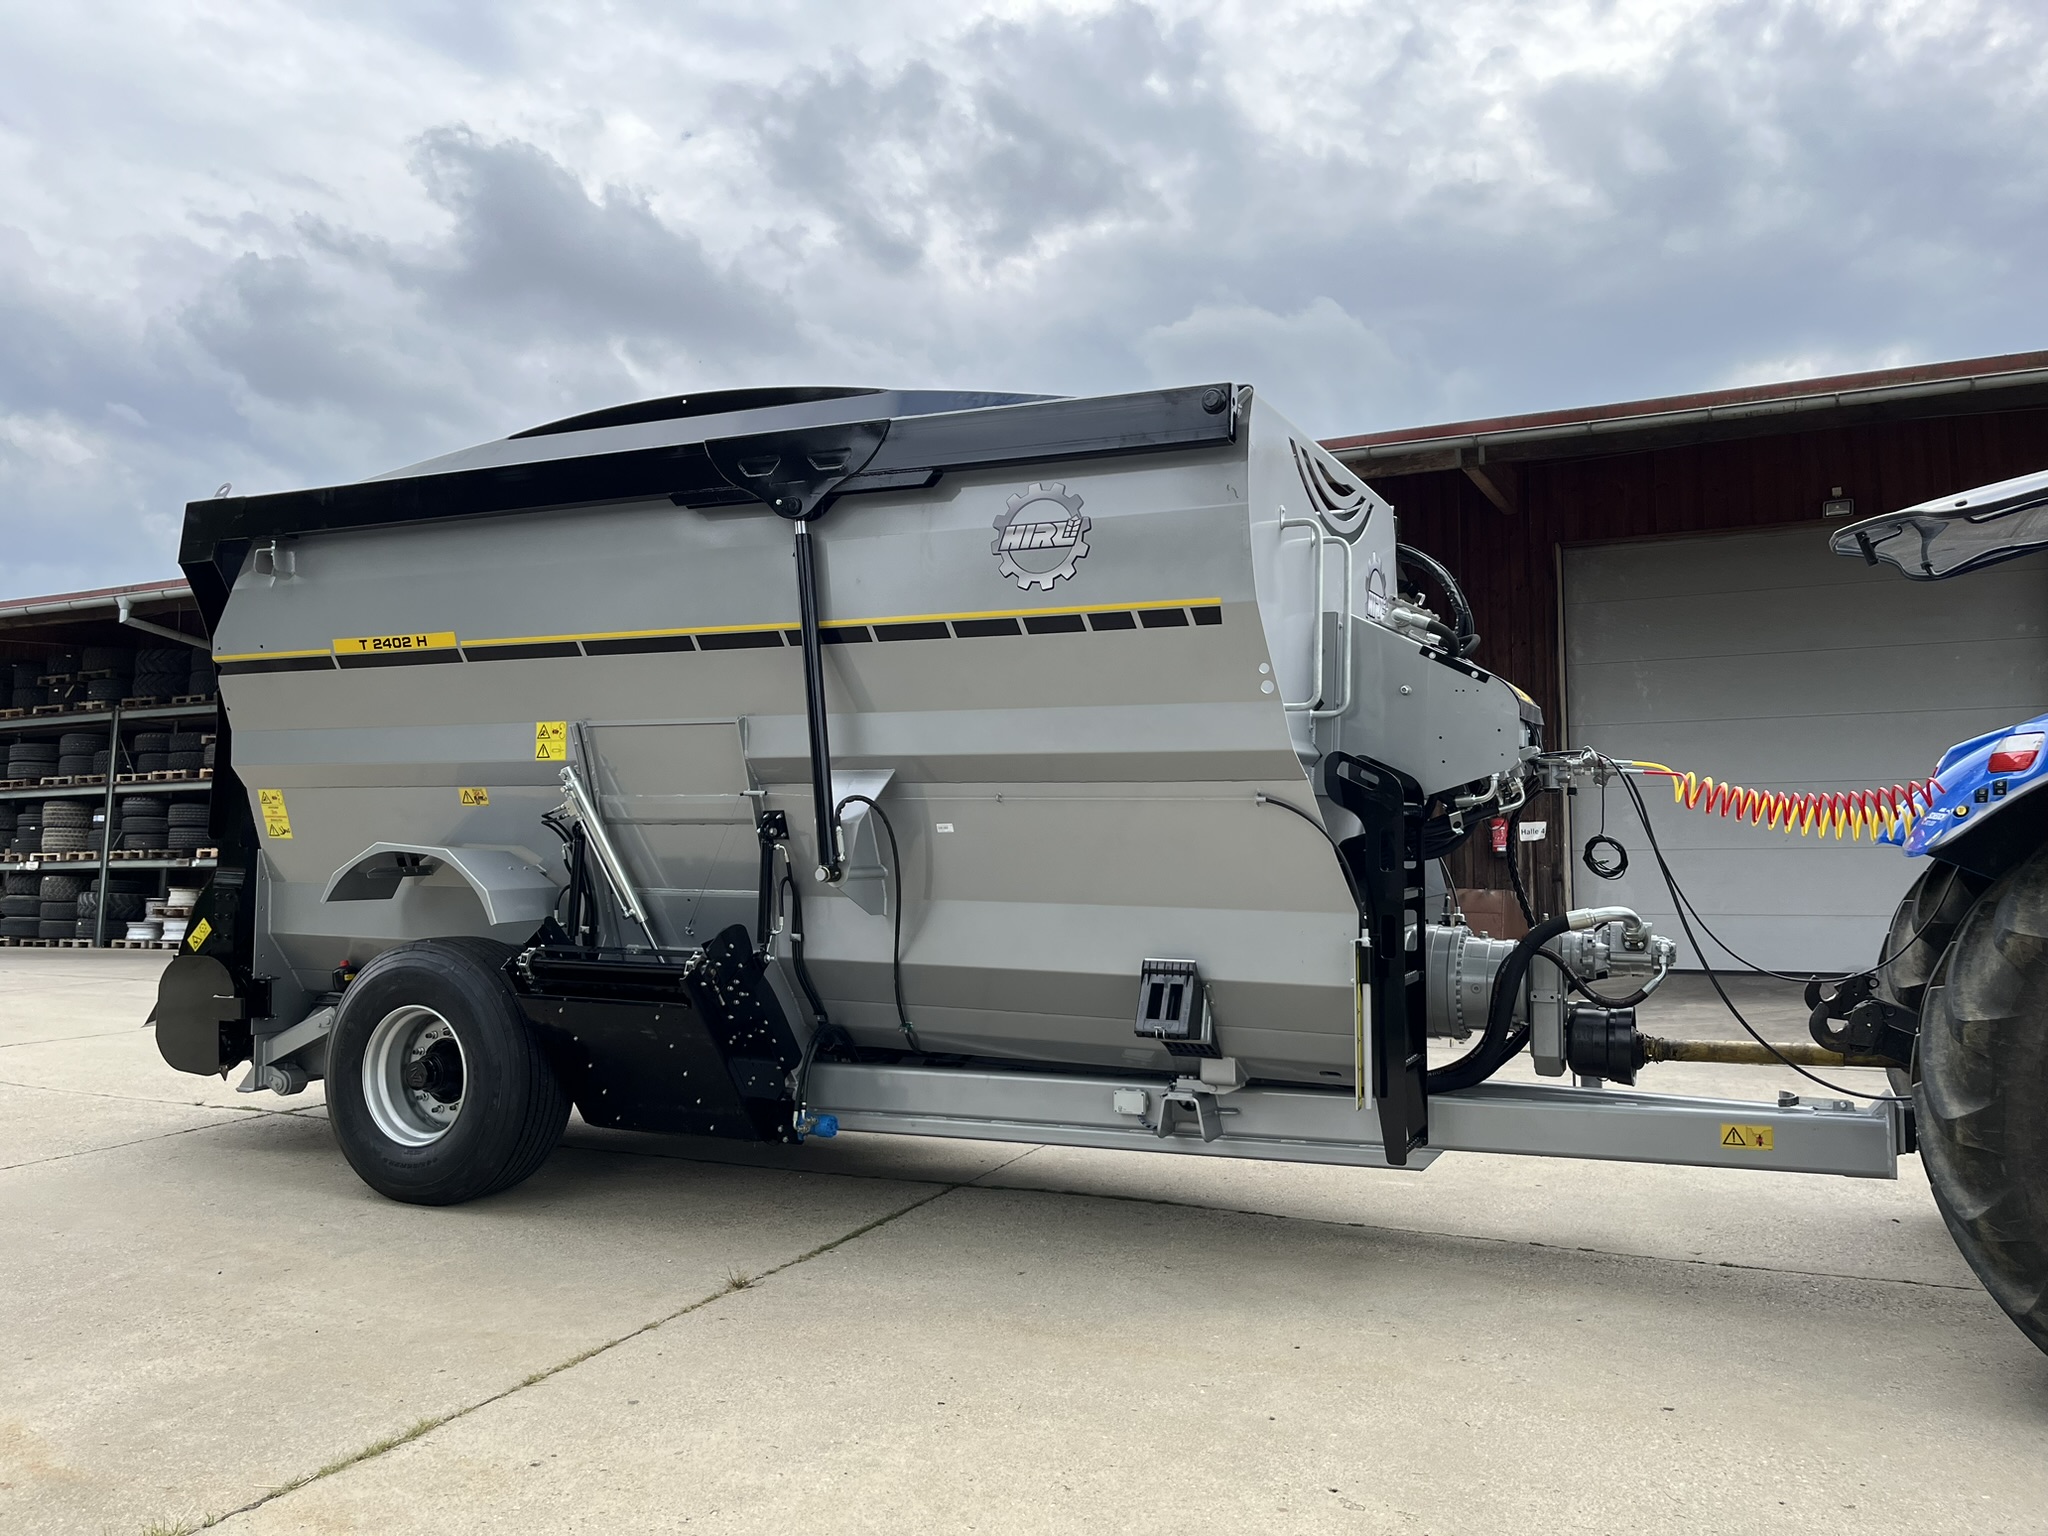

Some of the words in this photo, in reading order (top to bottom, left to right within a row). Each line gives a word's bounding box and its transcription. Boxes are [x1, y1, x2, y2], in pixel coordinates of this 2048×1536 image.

[999, 518, 1081, 551] HIRL
[359, 640, 367, 650] T
[373, 637, 411, 649] 2402
[416, 636, 427, 646] H
